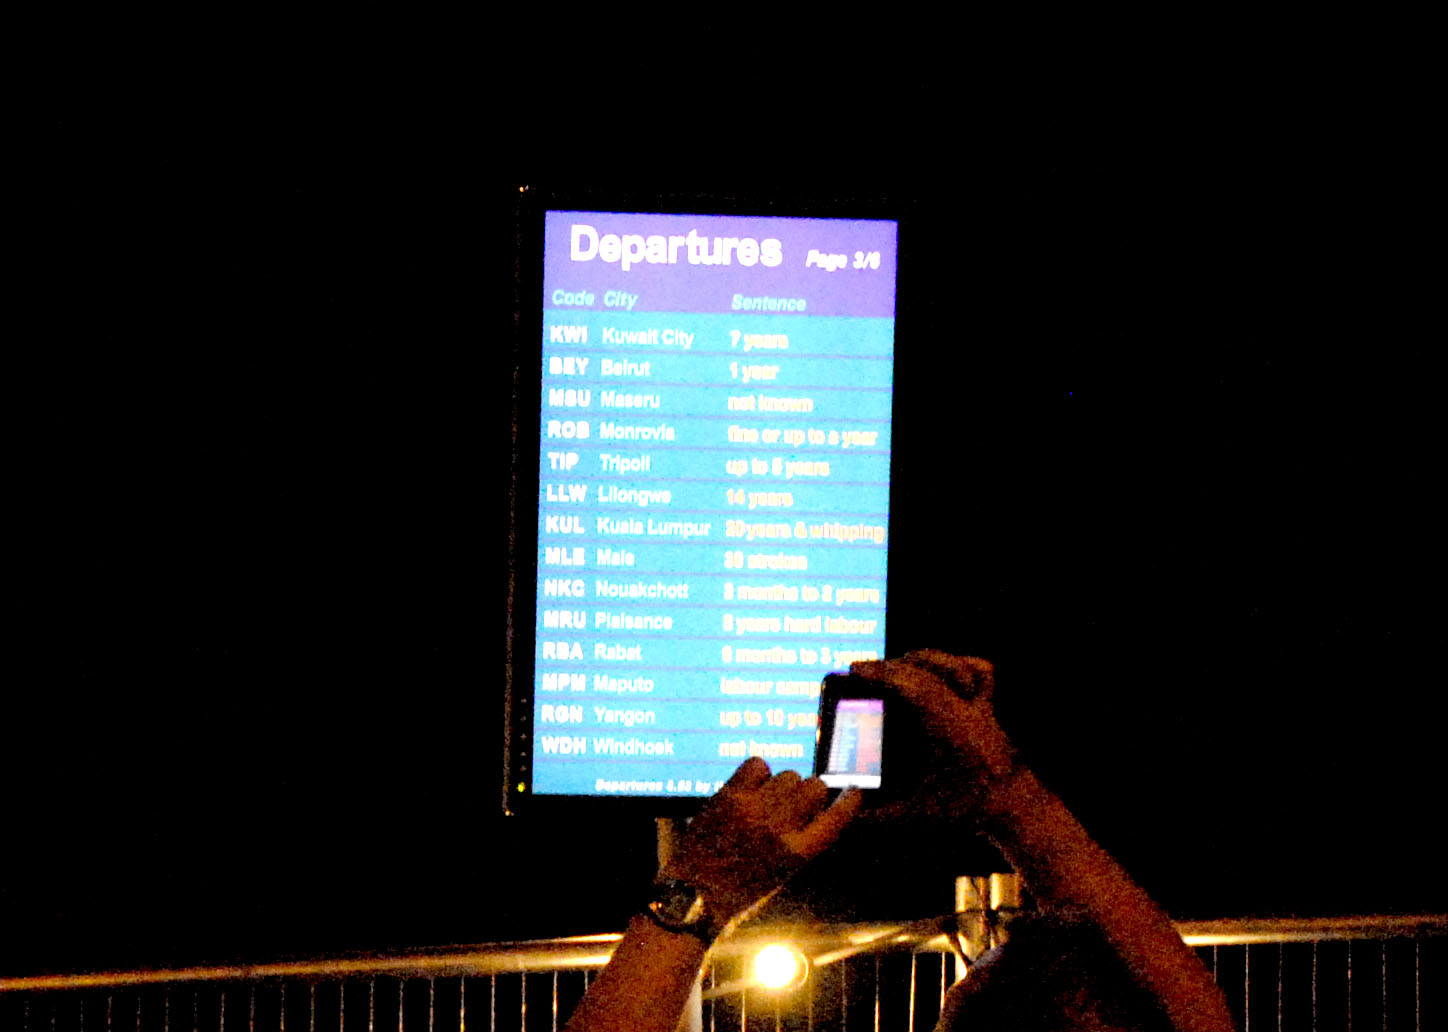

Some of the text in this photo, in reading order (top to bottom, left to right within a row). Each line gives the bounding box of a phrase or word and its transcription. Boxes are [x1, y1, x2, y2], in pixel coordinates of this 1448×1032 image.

[571, 225, 783, 271] Departures
[806, 249, 847, 271] Page
[552, 289, 806, 311] Code City Sentence
[551, 326, 587, 342] KWI
[603, 328, 658, 344] Kuwait
[550, 357, 588, 374] BEY
[602, 360, 650, 376] Beirut
[602, 391, 659, 407] Maseru
[548, 421, 589, 438] ROB
[601, 423, 674, 440] Monrovia
[548, 453, 578, 469] TIP
[600, 455, 649, 473] Tripoli
[547, 485, 587, 501] LLW
[599, 486, 671, 506] Lilongwe
[546, 516, 584, 533] KUL
[598, 518, 643, 534] Kuala
[546, 548, 634, 565] MLE Male
[545, 580, 584, 596] NKC
[597, 581, 688, 598] Nouakchott
[544, 611, 585, 628] MRU
[596, 613, 672, 629] Plaisance
[543, 642, 583, 659] RBA
[595, 644, 641, 660] Rabat
[543, 674, 586, 691] MPM
[595, 676, 653, 694] Maputo
[542, 705, 582, 722] RGN
[595, 707, 654, 726] Yangon
[542, 737, 586, 753] WDH
[594, 739, 673, 754] Windhoek
